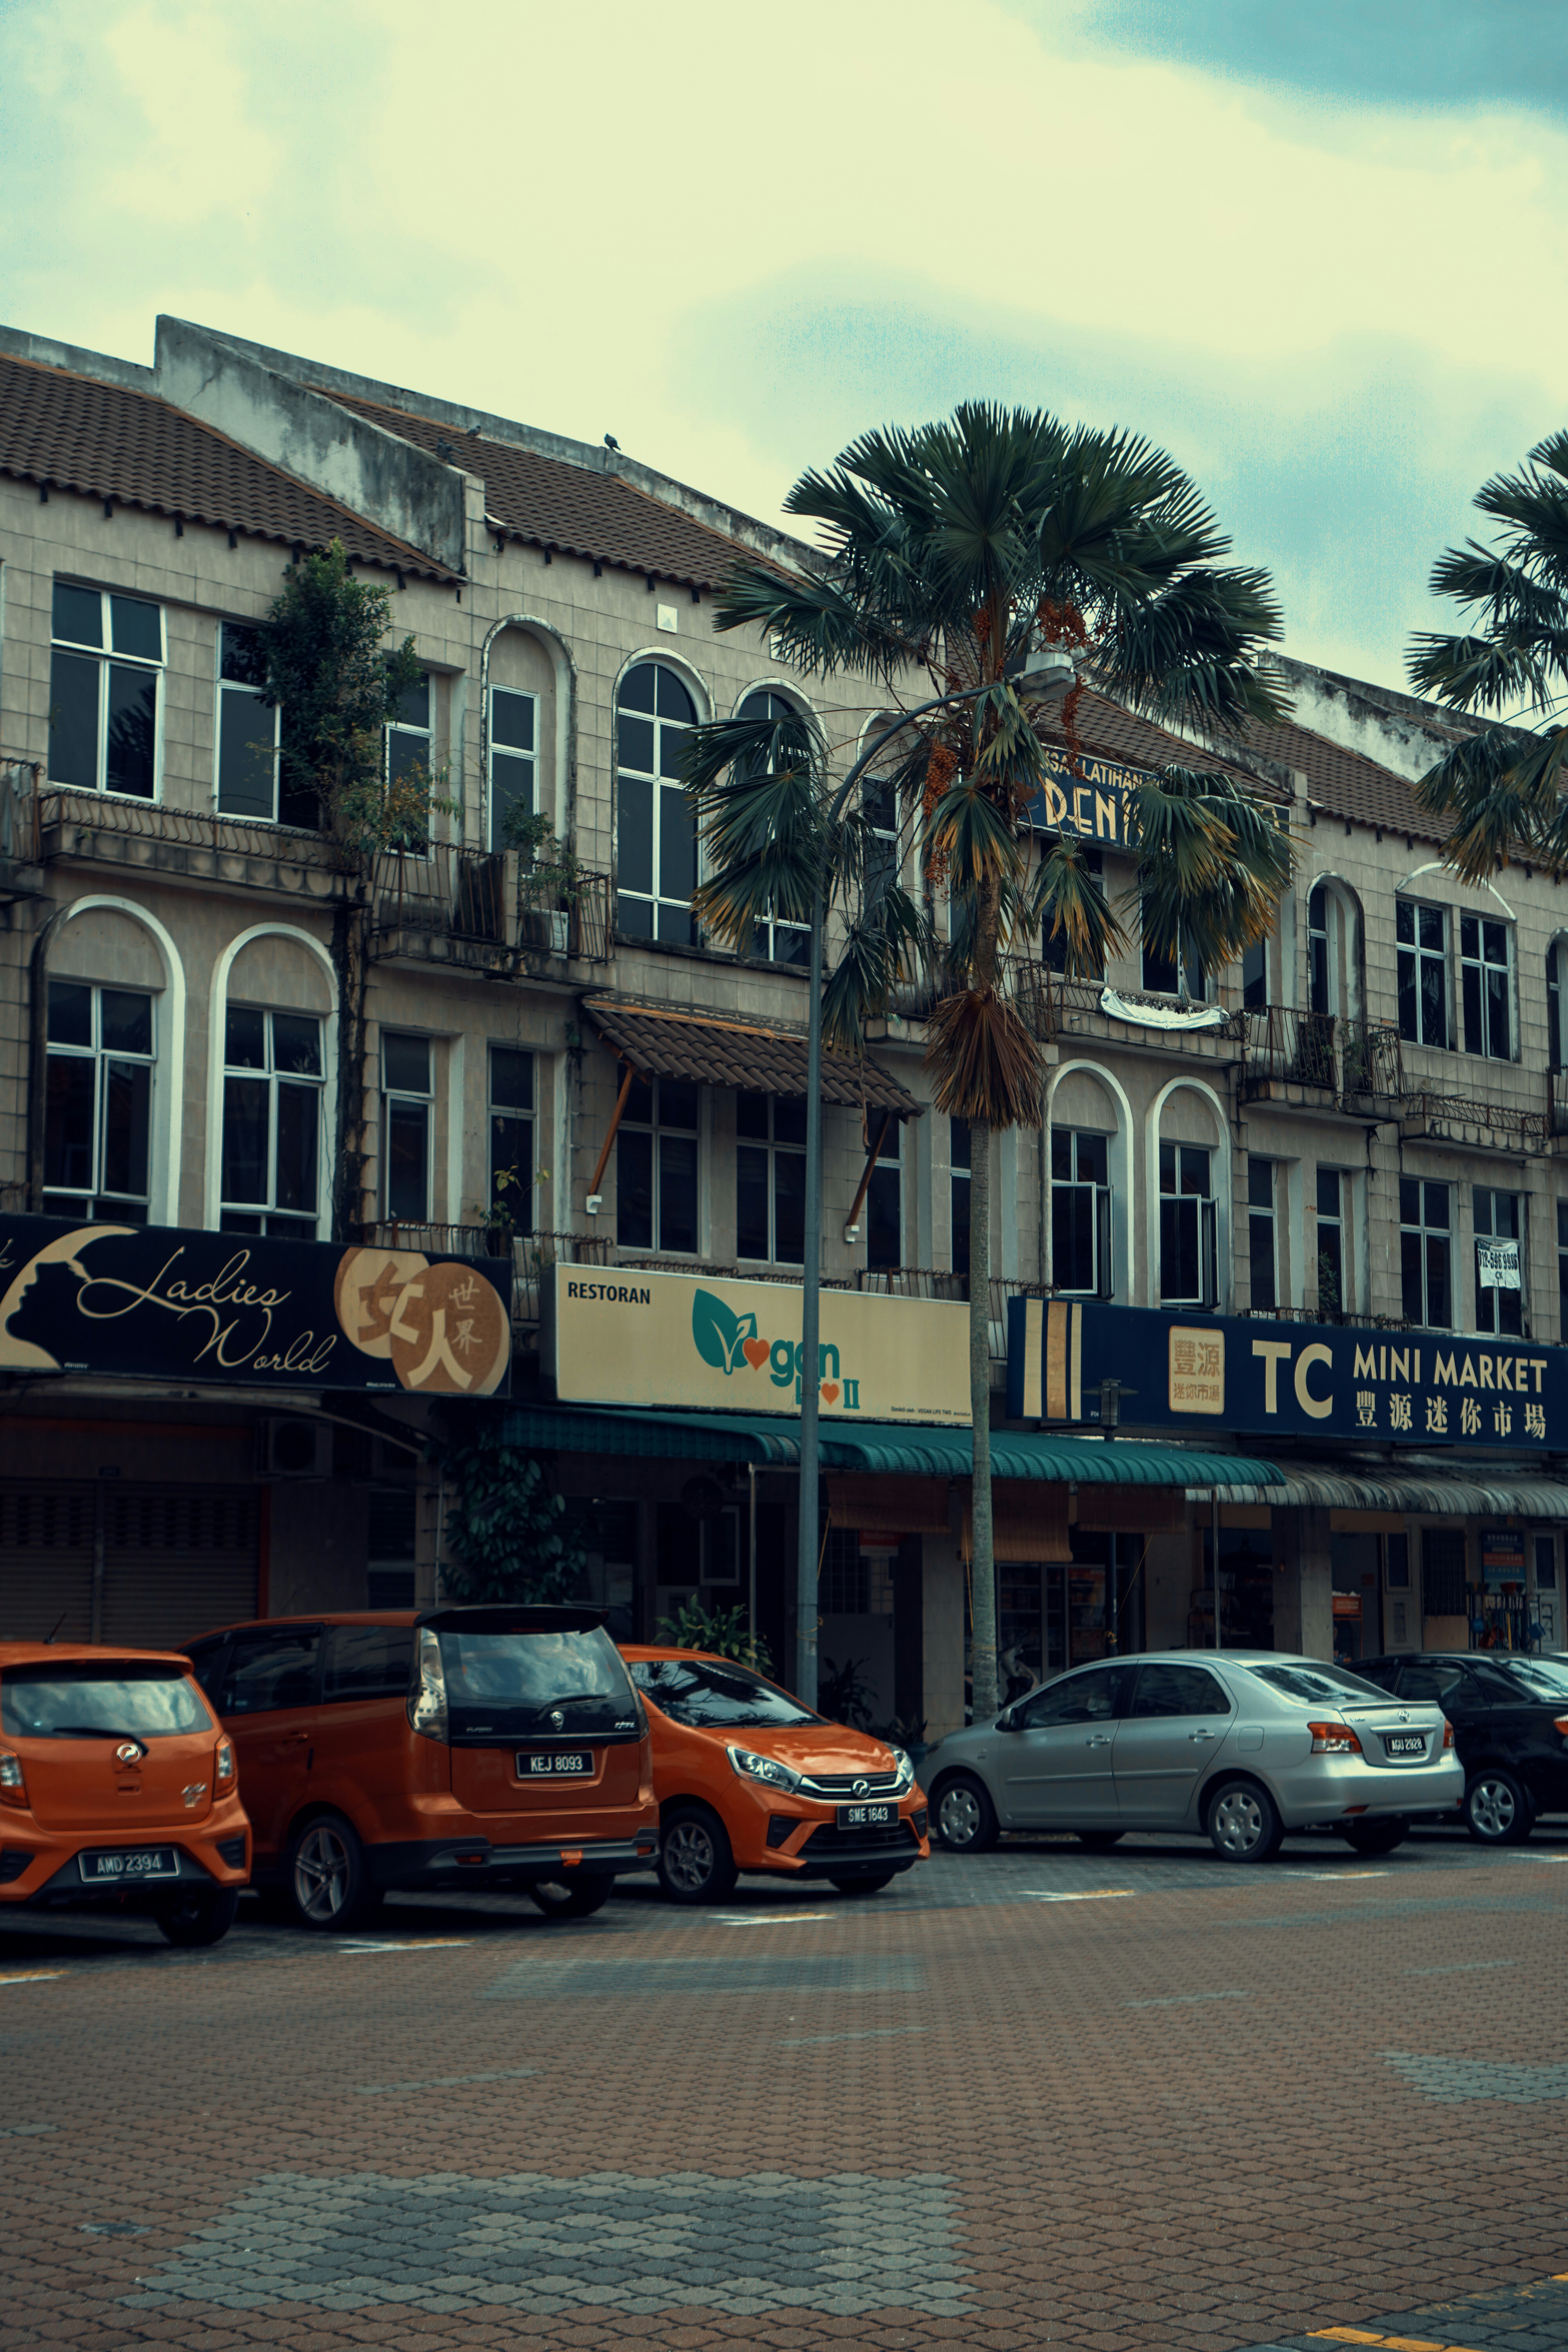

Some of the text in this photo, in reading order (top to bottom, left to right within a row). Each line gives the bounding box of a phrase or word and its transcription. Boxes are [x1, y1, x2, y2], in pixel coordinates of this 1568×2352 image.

[76, 1245, 291, 1319] Ladies
[568, 1281, 650, 1304] RESTORAN
[176, 1303, 338, 1373] World
[1252, 1339, 1333, 1419] TC
[1353, 1342, 1548, 1393] MINI MARKET
[530, 1755, 583, 1772] KEJ 8093
[97, 1852, 163, 1874] AMD 2394
